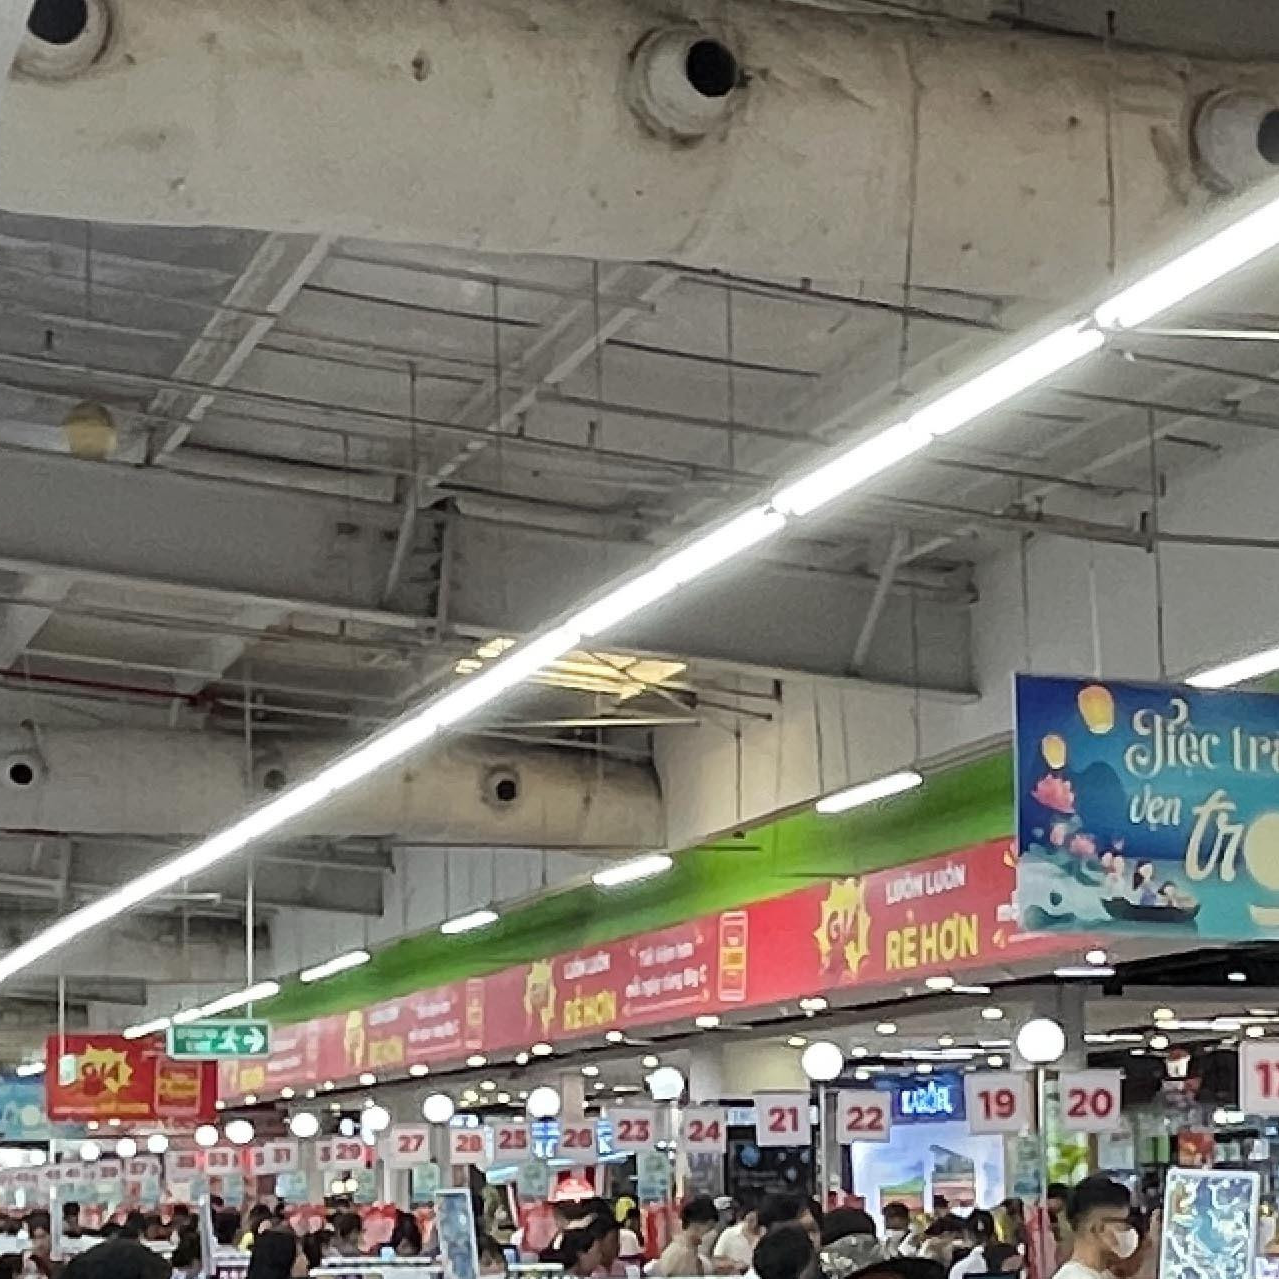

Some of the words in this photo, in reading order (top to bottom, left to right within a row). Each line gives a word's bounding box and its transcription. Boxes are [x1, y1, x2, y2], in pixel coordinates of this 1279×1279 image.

[922, 911, 979, 964] HƠN
[977, 1089, 1016, 1119] 19
[1067, 1088, 1112, 1117] 20
[618, 1120, 650, 1141] 23
[688, 1120, 720, 1141] 24
[768, 1106, 799, 1132] 21
[847, 1106, 883, 1132] 22
[397, 1134, 424, 1152] 27
